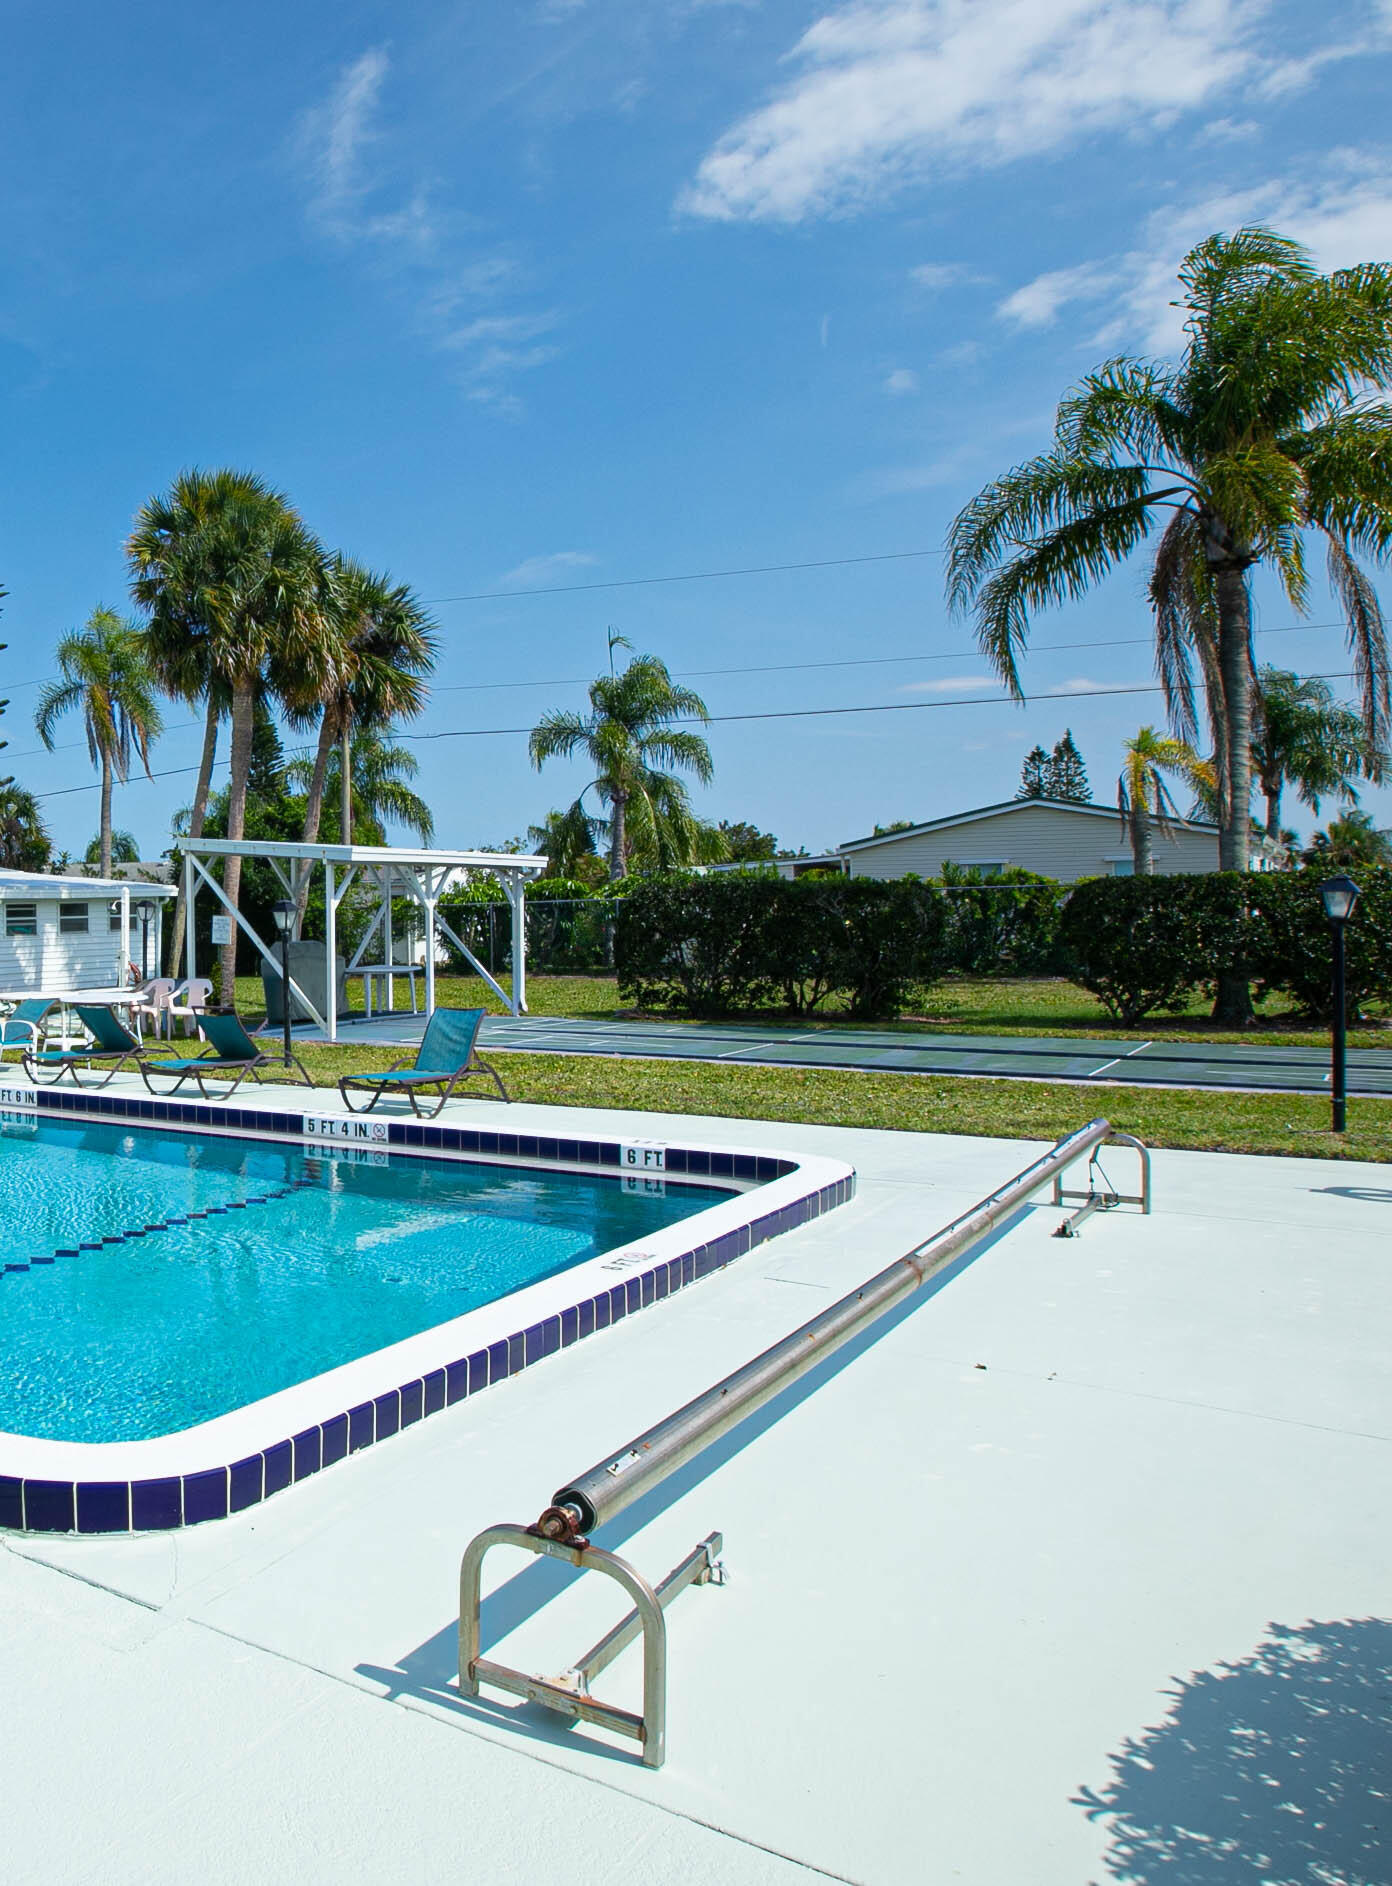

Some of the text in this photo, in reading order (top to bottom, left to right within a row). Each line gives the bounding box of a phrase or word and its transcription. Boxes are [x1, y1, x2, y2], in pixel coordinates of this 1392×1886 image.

[15, 1090, 21, 1103] 6
[308, 1119, 315, 1132] 5
[341, 1121, 349, 1136] 4
[627, 1148, 636, 1164] 6
